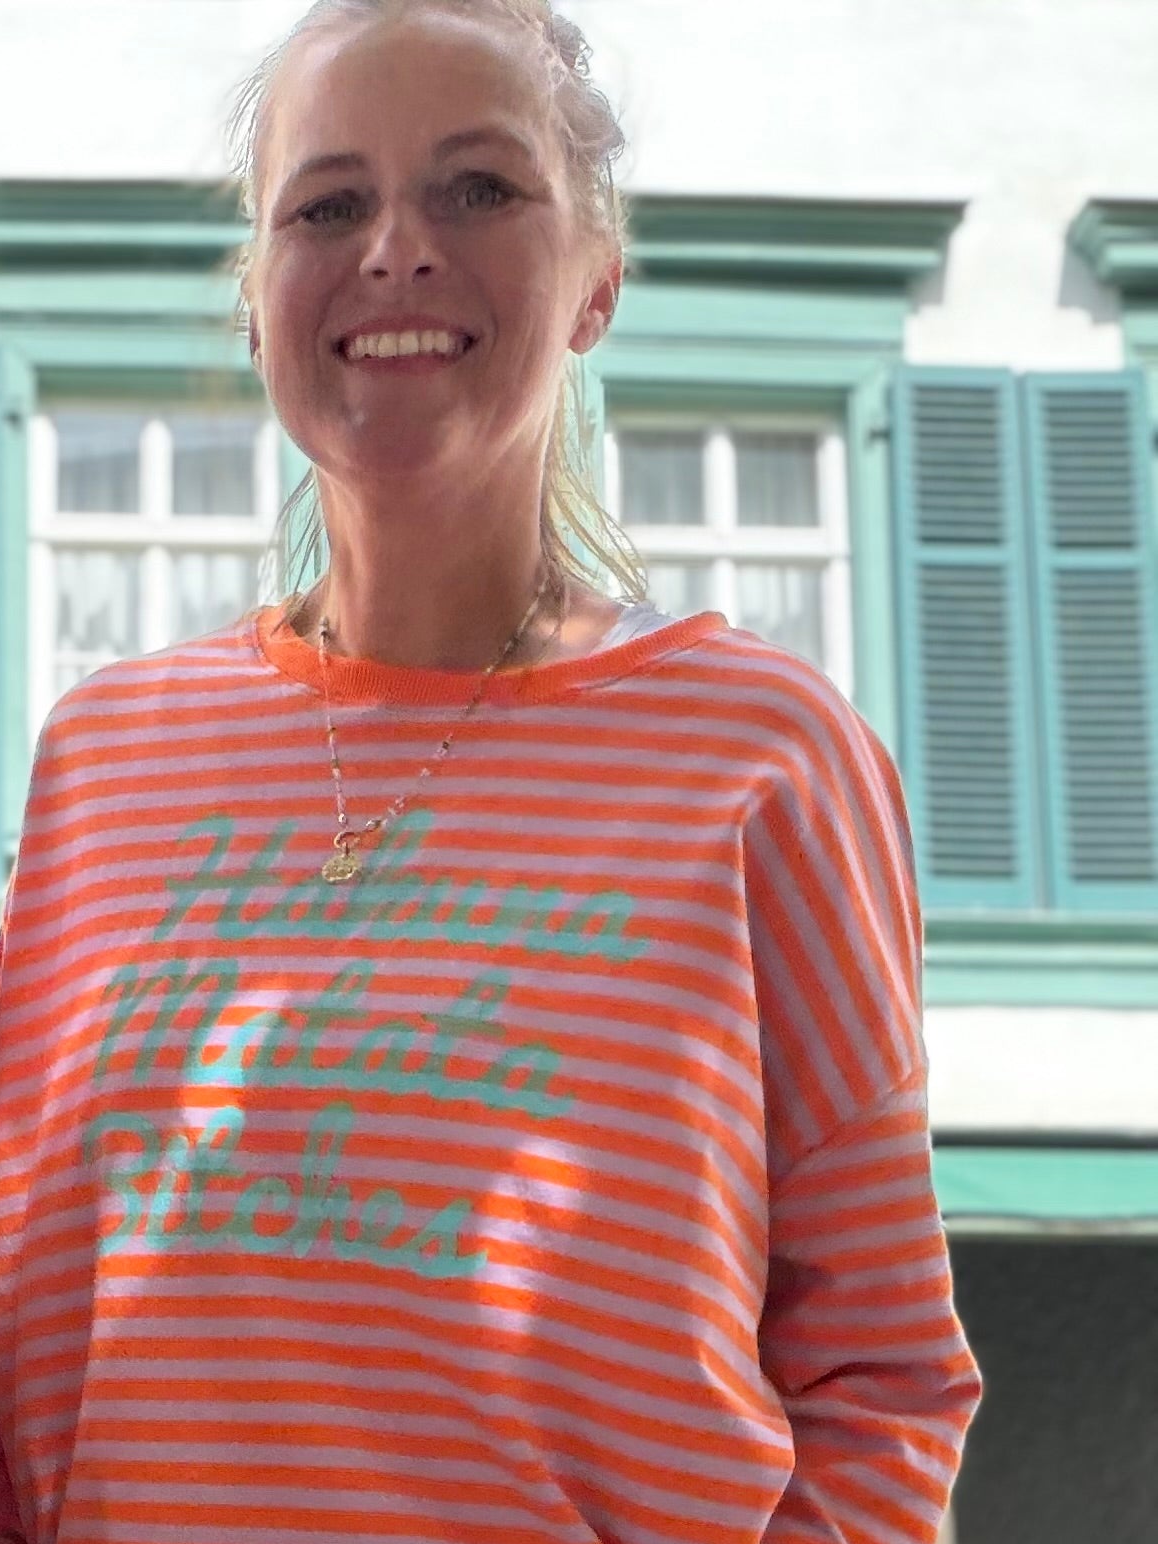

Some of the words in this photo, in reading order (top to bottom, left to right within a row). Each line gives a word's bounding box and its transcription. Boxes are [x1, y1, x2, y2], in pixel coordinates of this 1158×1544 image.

[152, 809, 649, 961] Hakuna
[92, 958, 576, 1119] Matata
[81, 1100, 489, 1280] Bitches
